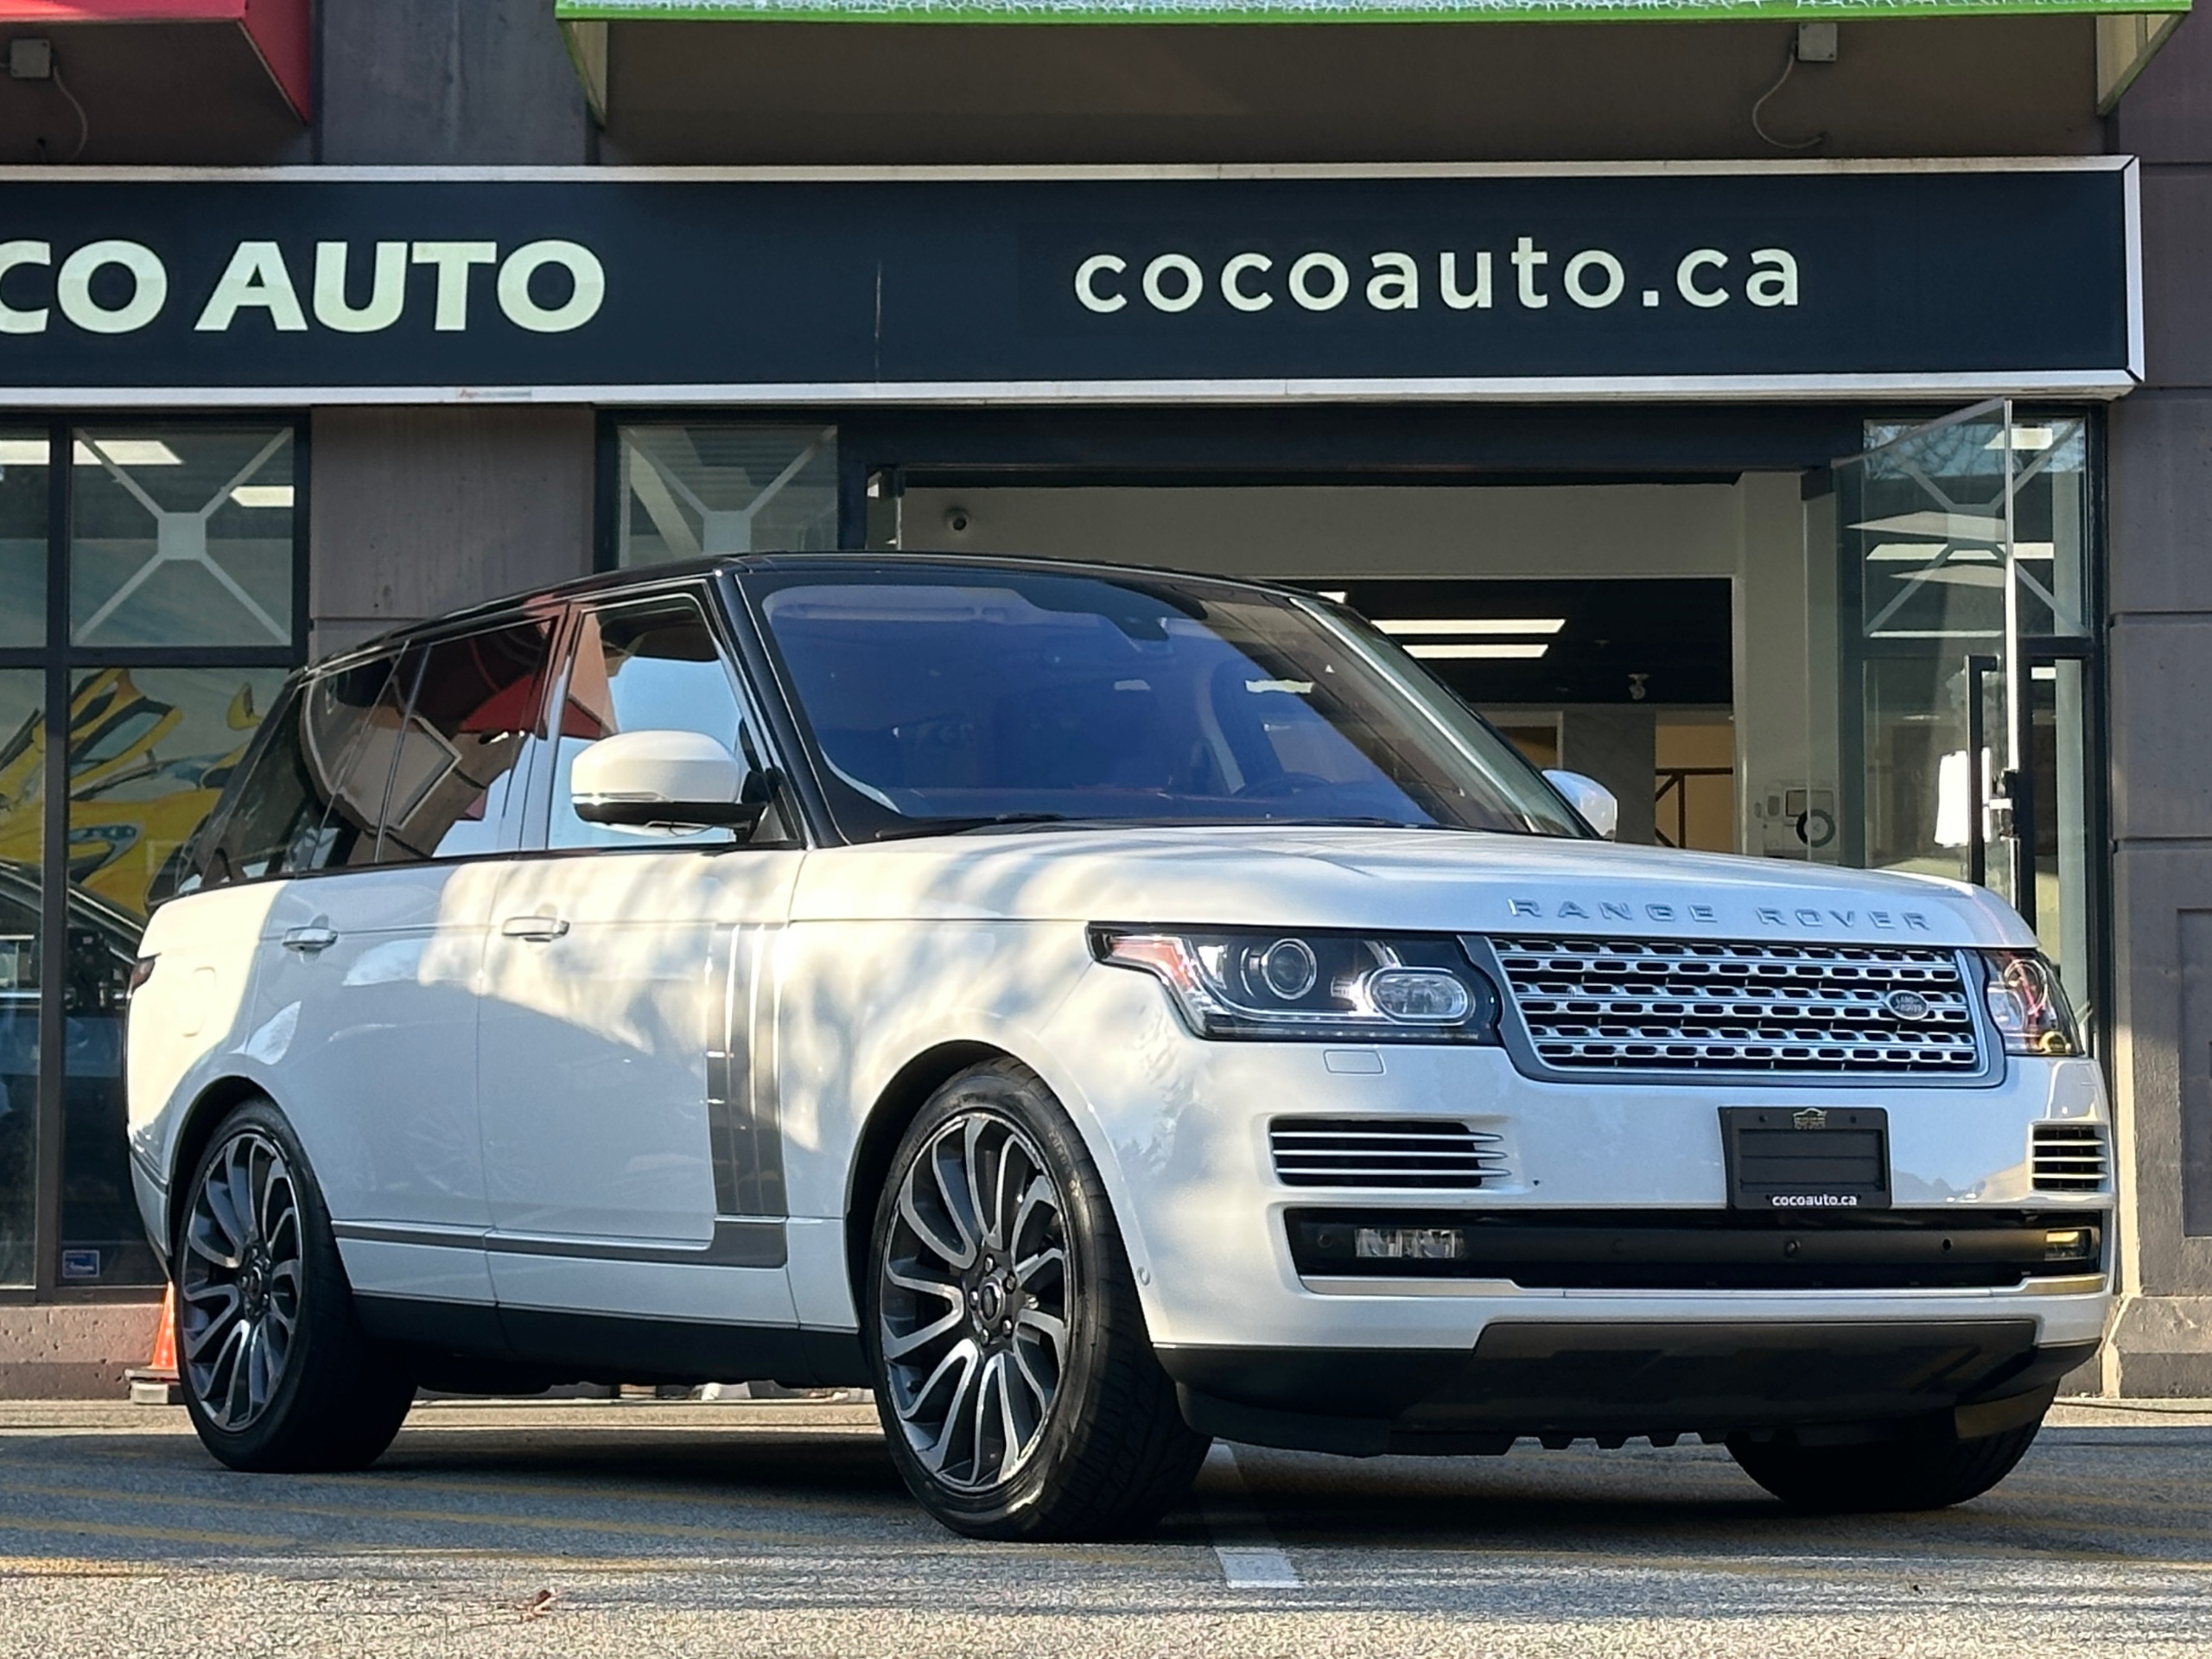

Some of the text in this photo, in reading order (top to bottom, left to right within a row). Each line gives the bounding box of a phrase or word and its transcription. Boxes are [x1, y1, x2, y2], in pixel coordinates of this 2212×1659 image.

[194, 239, 606, 334] AUTO
[1074, 236, 1800, 314] cocoauto.ca
[1507, 898, 1931, 931] RANGE ROVER
[1771, 1194, 1858, 1207] cocoauto.ca
